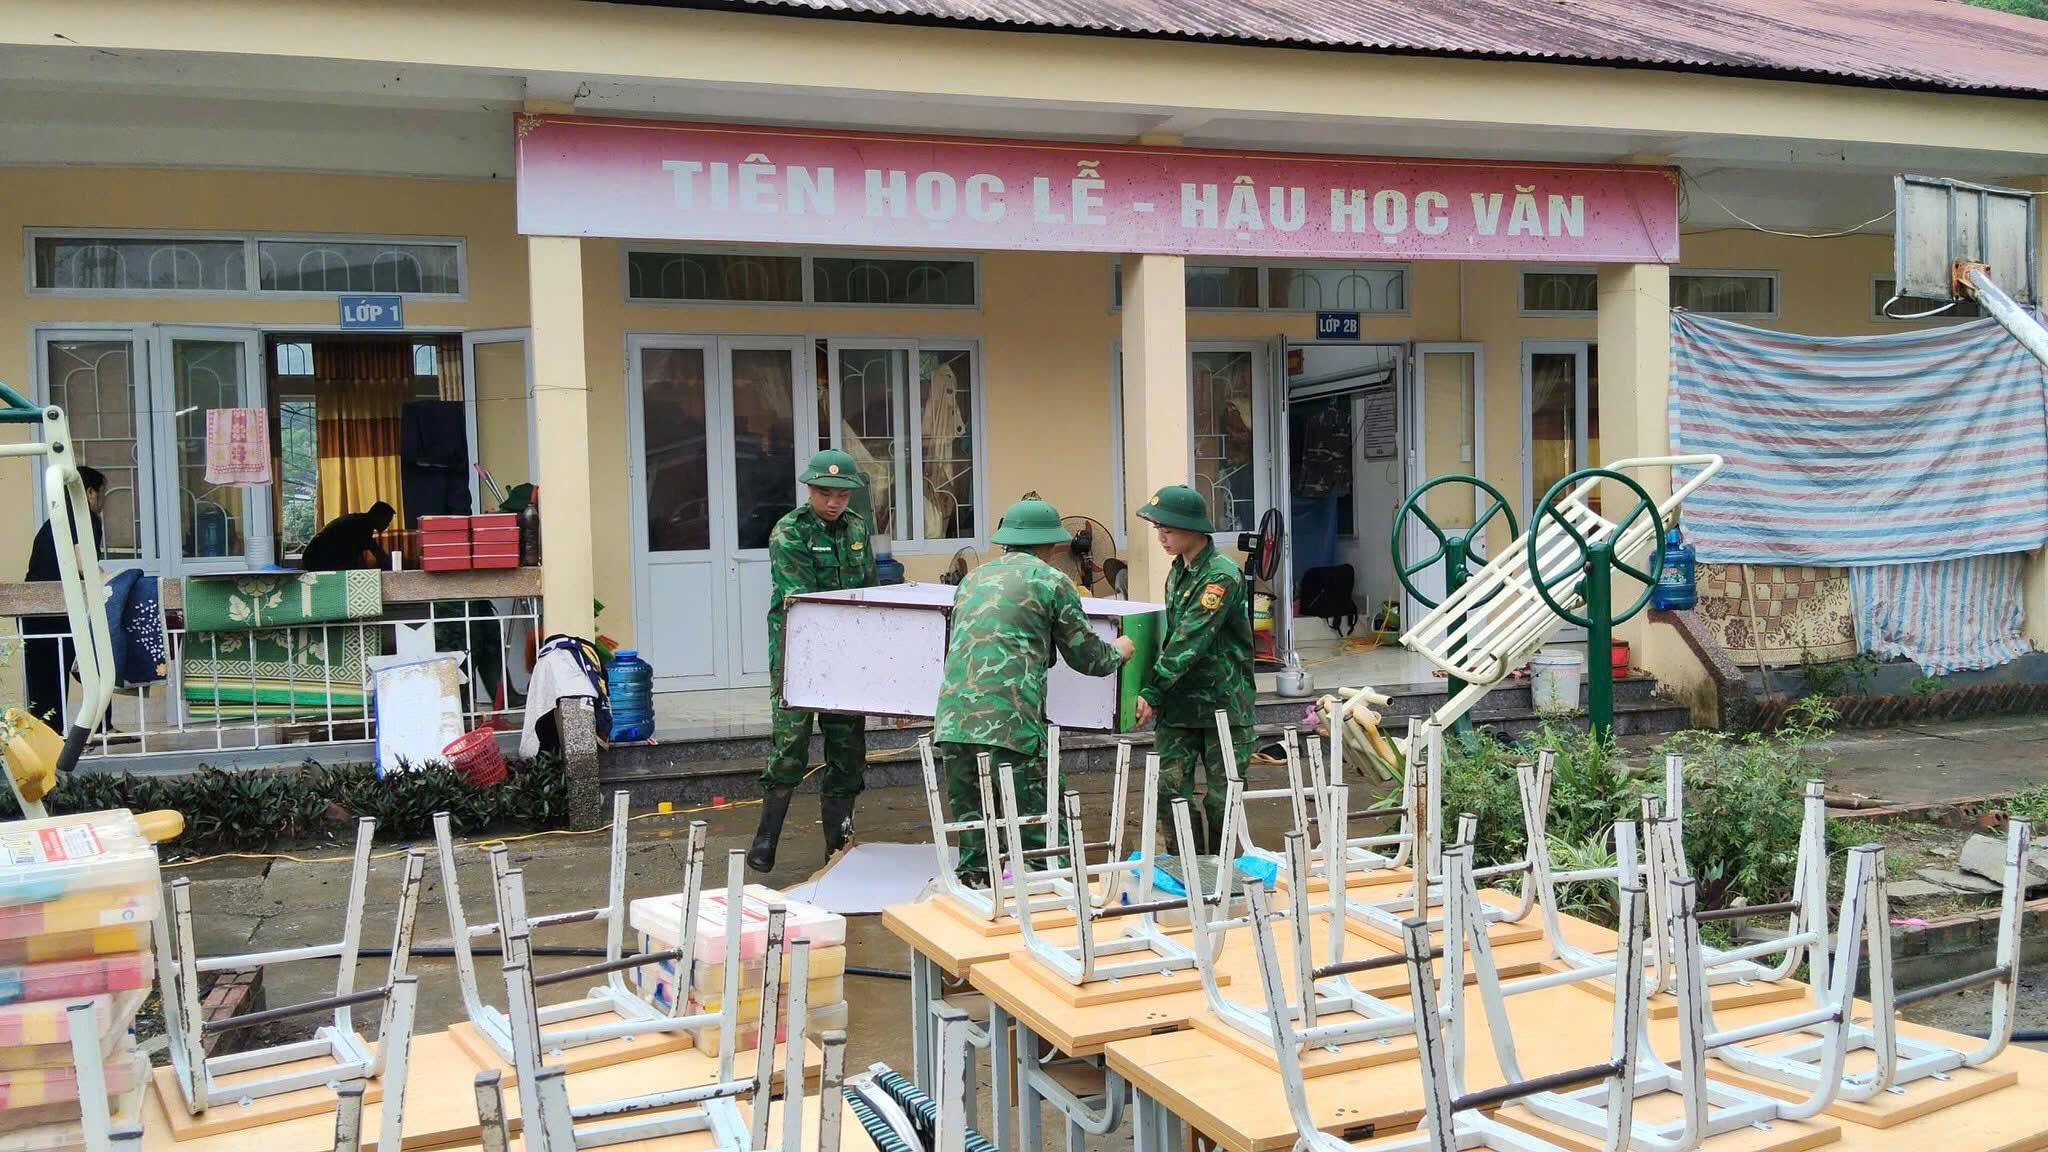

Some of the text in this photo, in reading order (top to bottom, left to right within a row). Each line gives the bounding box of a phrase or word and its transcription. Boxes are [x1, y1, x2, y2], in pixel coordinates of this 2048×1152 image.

[661, 153, 1585, 244] TIÊN HỌC LỄ - HẬU HỌC VĂN
[344, 299, 399, 322] LỚP 1
[1319, 314, 1358, 333] LỚP 2B
